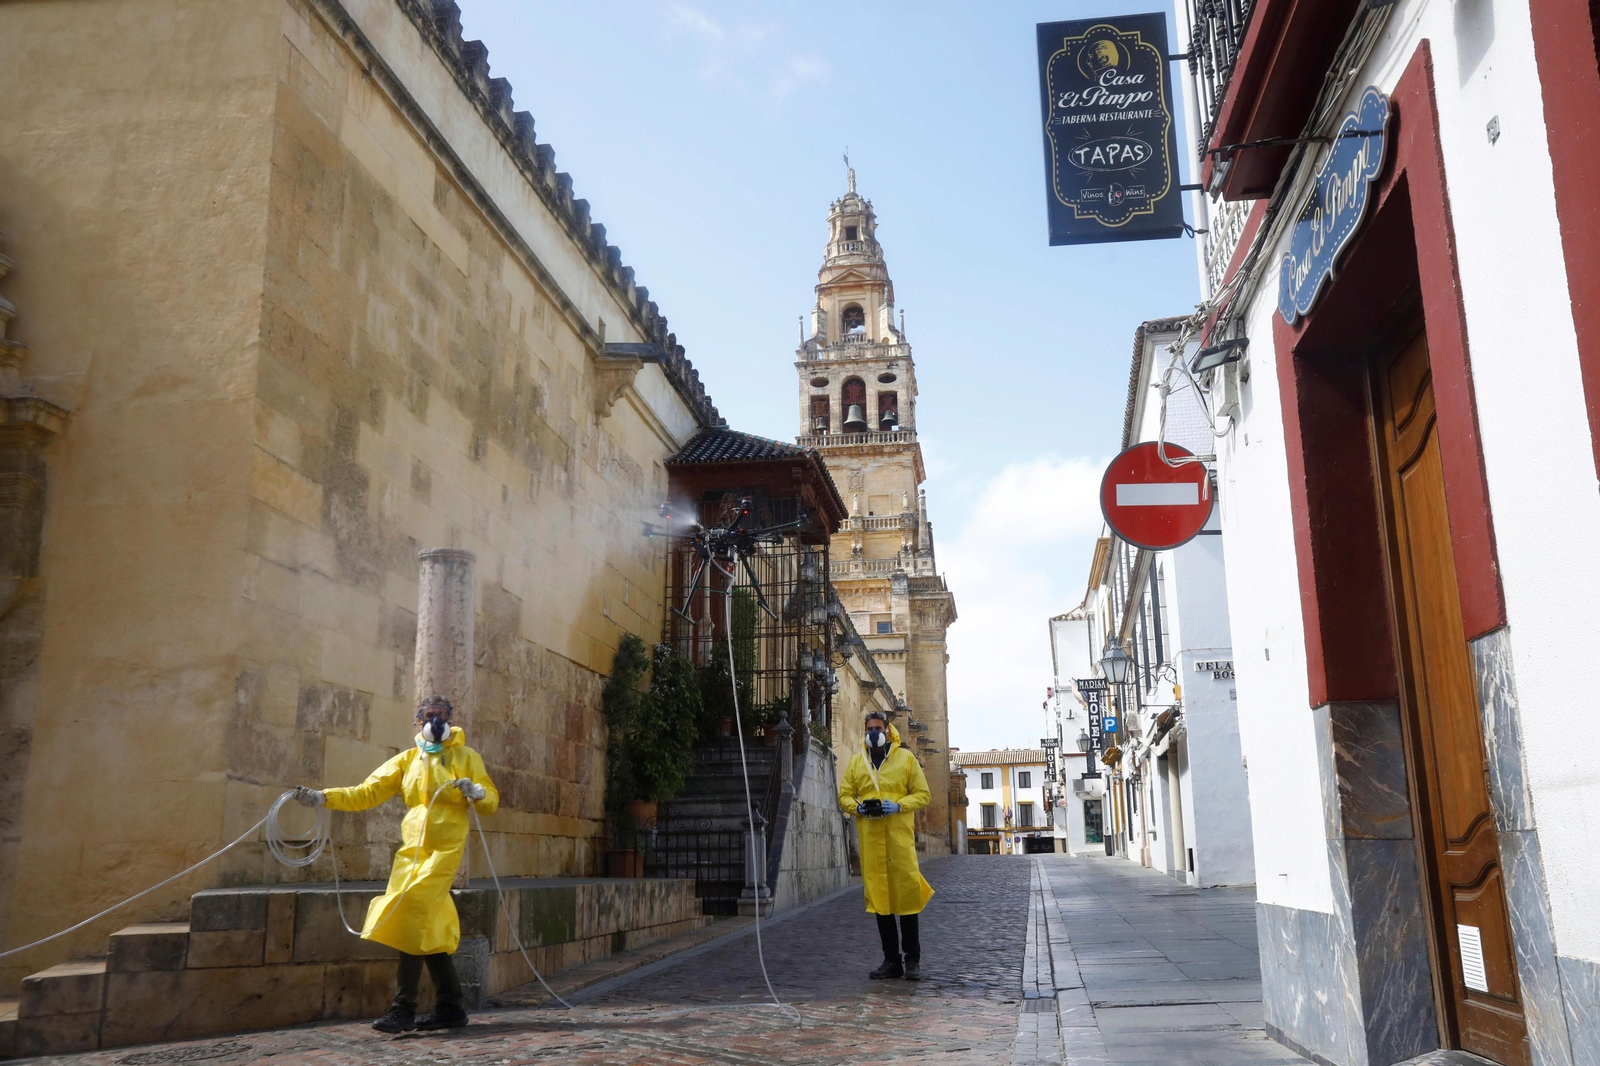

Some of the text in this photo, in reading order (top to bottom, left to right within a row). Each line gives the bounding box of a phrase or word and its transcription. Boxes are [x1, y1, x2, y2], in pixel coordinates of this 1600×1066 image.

[1099, 68, 1146, 87] Casa
[1058, 85, 1153, 110] El Pimpo
[1075, 143, 1144, 165] TAPAS
[1082, 190, 1104, 199] Vinos
[1288, 136, 1370, 301] Casa El Pimpo
[1078, 680, 1106, 690] MARISA
[1088, 691, 1101, 749] HOTEL
[1104, 718, 1116, 731] P
[1047, 748, 1056, 782] HOTEL
